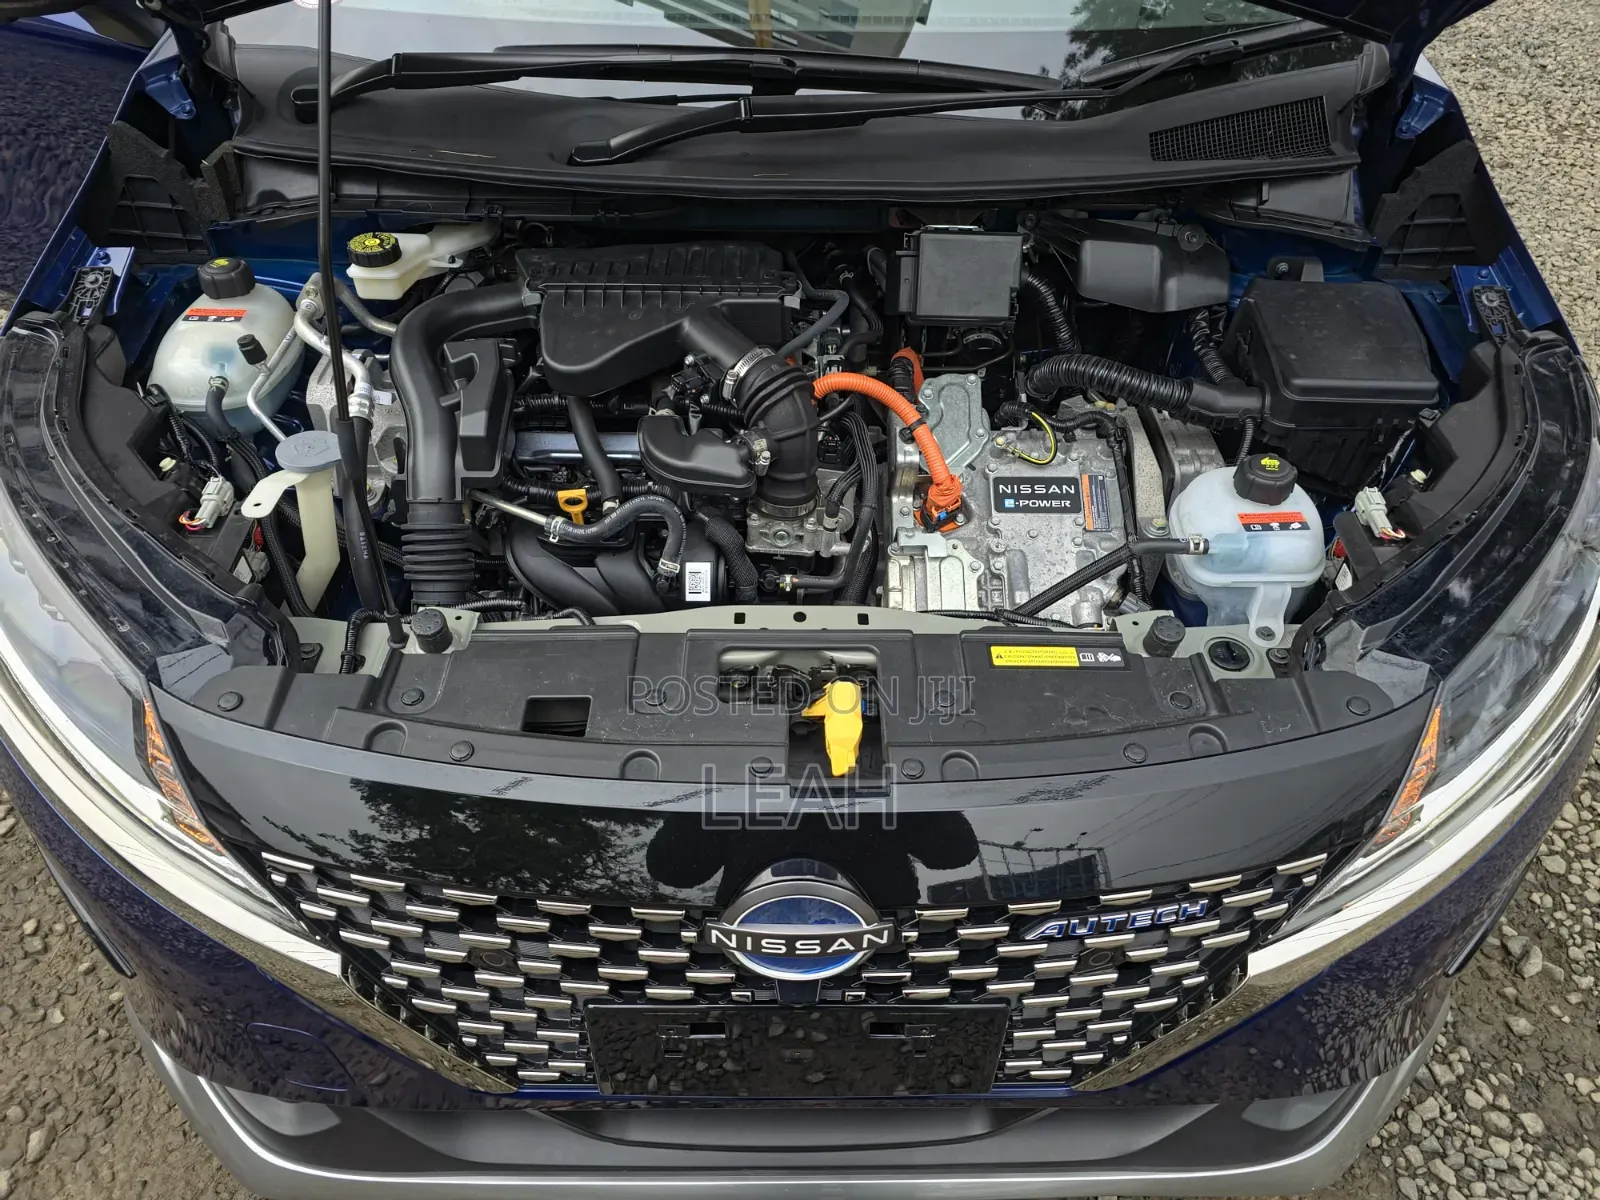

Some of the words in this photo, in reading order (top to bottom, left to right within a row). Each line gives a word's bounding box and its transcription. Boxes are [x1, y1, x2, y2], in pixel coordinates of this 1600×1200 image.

[999, 484, 1075, 494] NISSAN
[1024, 899, 1209, 941] AUTECH
[711, 929, 889, 955] NISSAN
